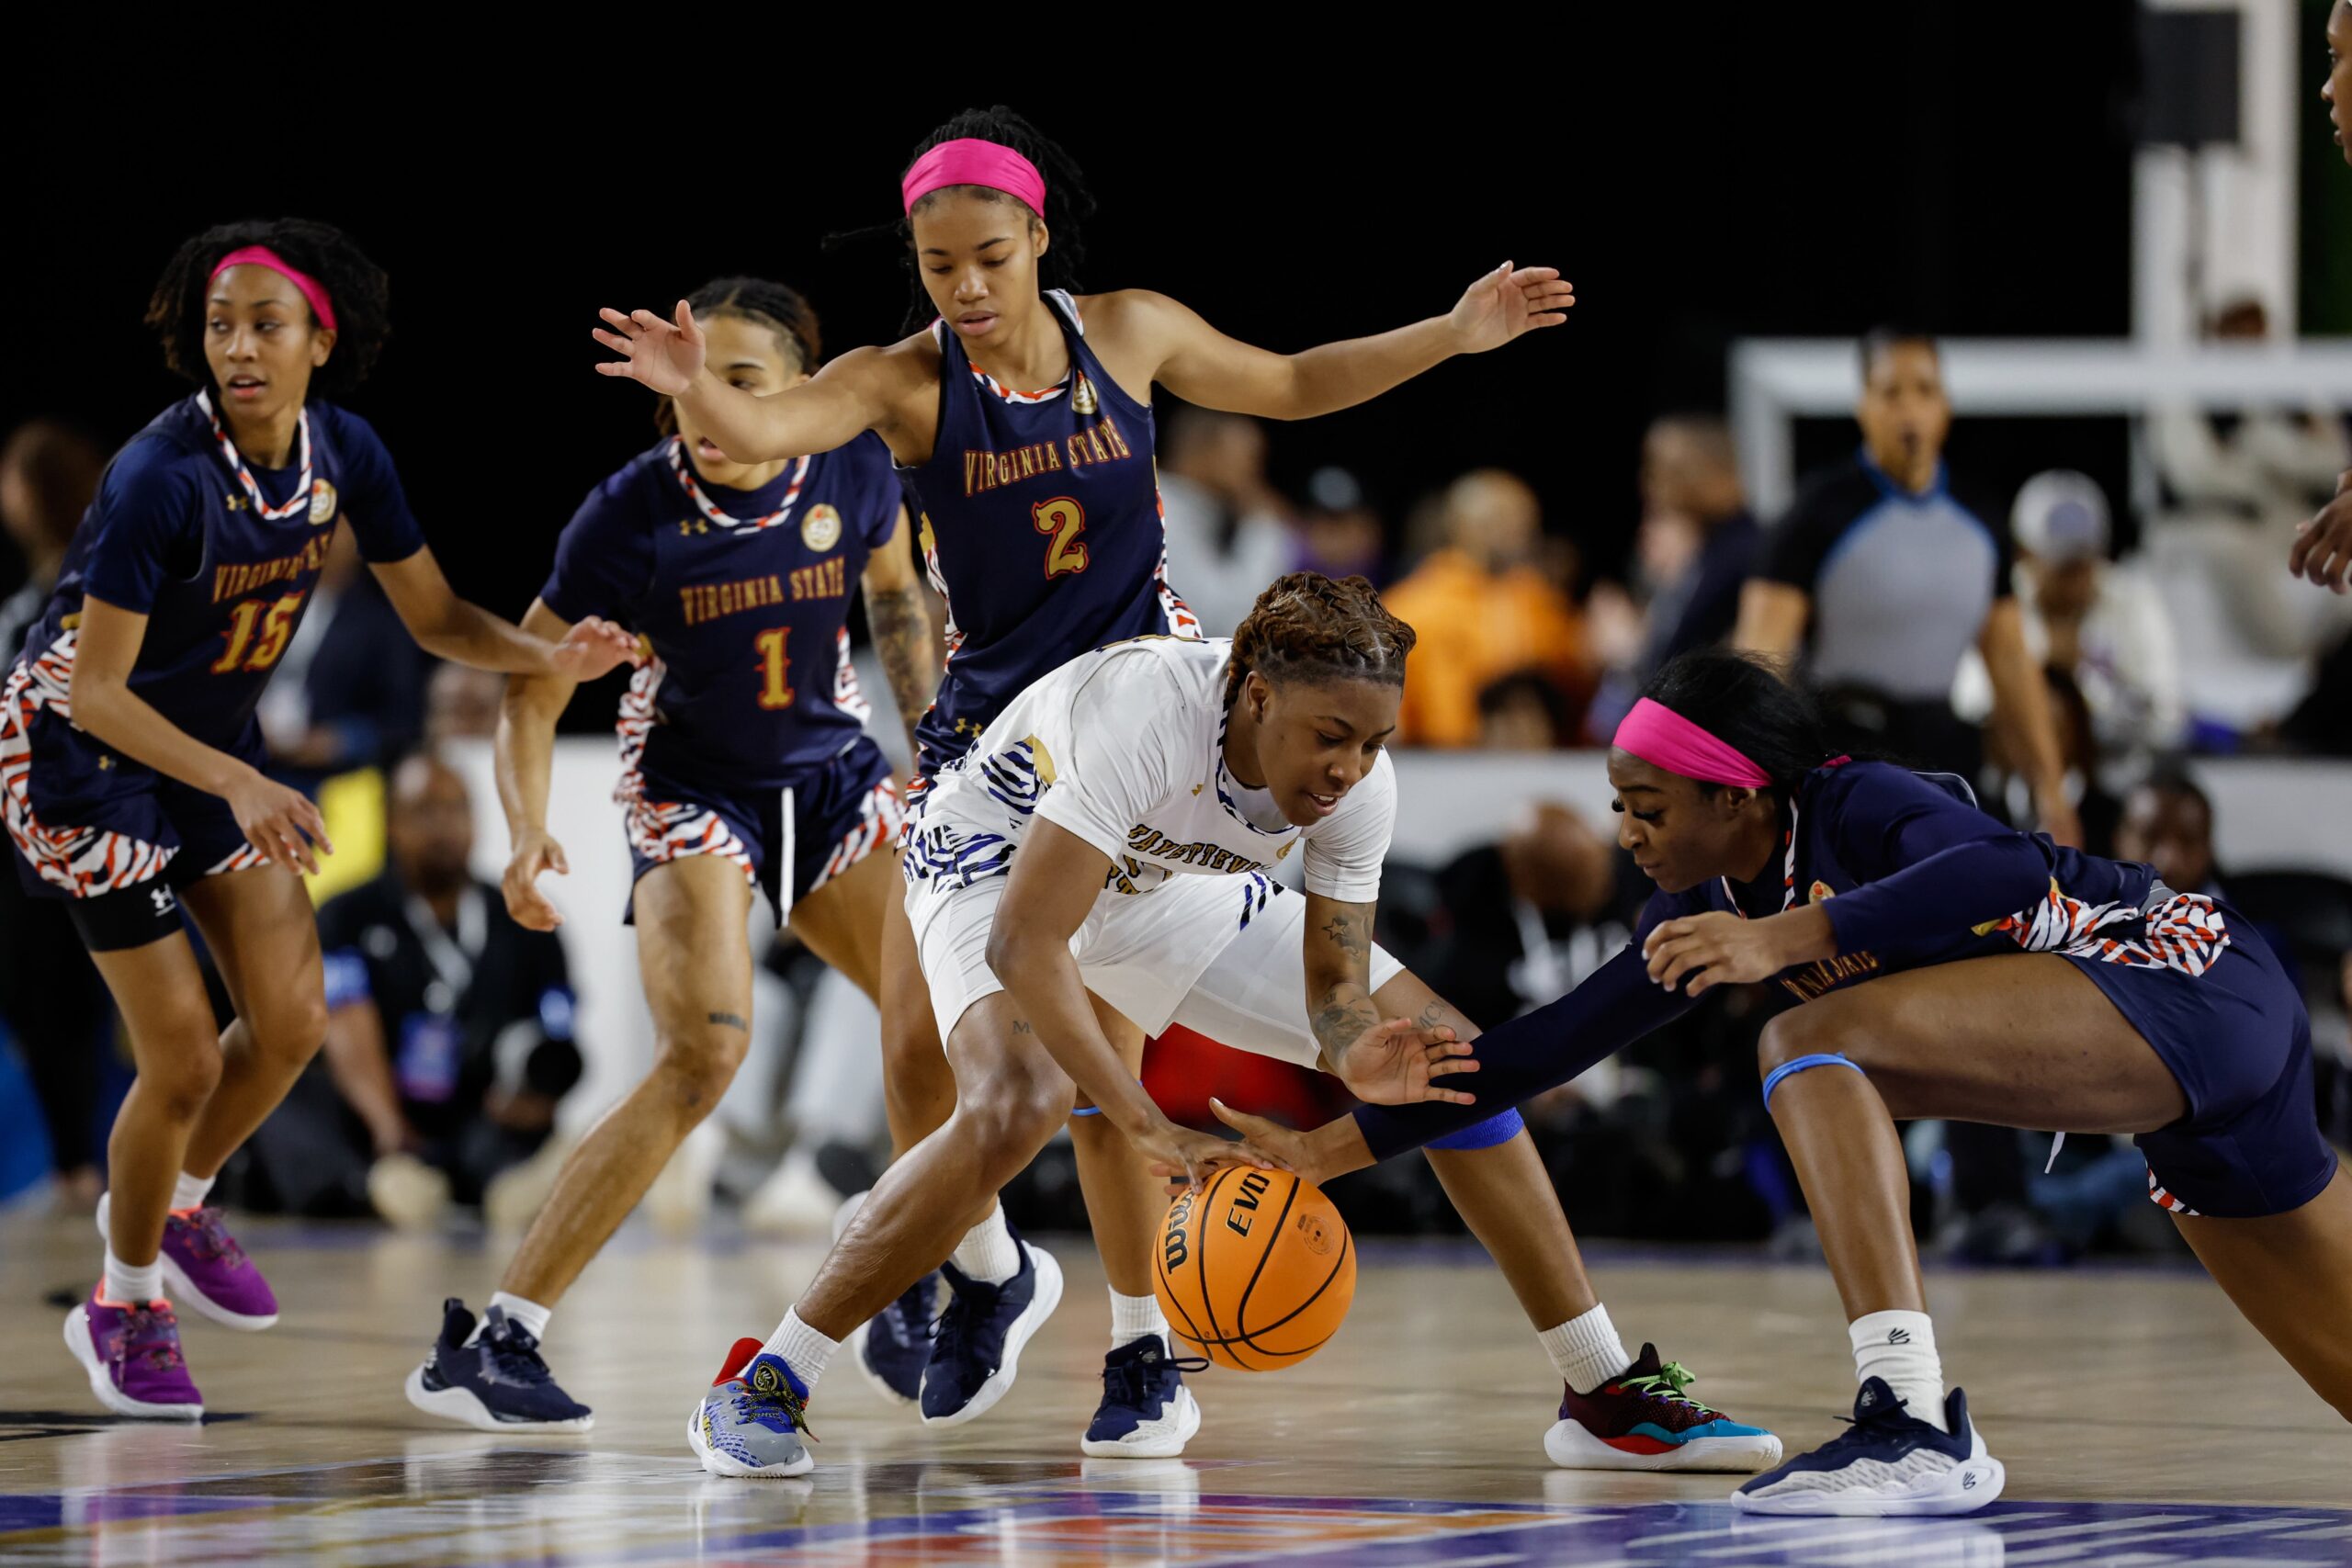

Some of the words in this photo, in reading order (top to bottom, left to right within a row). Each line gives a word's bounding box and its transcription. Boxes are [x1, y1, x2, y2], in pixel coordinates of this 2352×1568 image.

[963, 441, 1063, 497] VIRGINIA
[1066, 414, 1132, 469] STATE
[1031, 496, 1090, 581] 2
[210, 589, 306, 674] 15
[679, 574, 784, 627] VIRGINIA
[789, 555, 846, 602] STATE
[753, 626, 796, 711] 1
[1225, 1171, 1272, 1237] EVO
